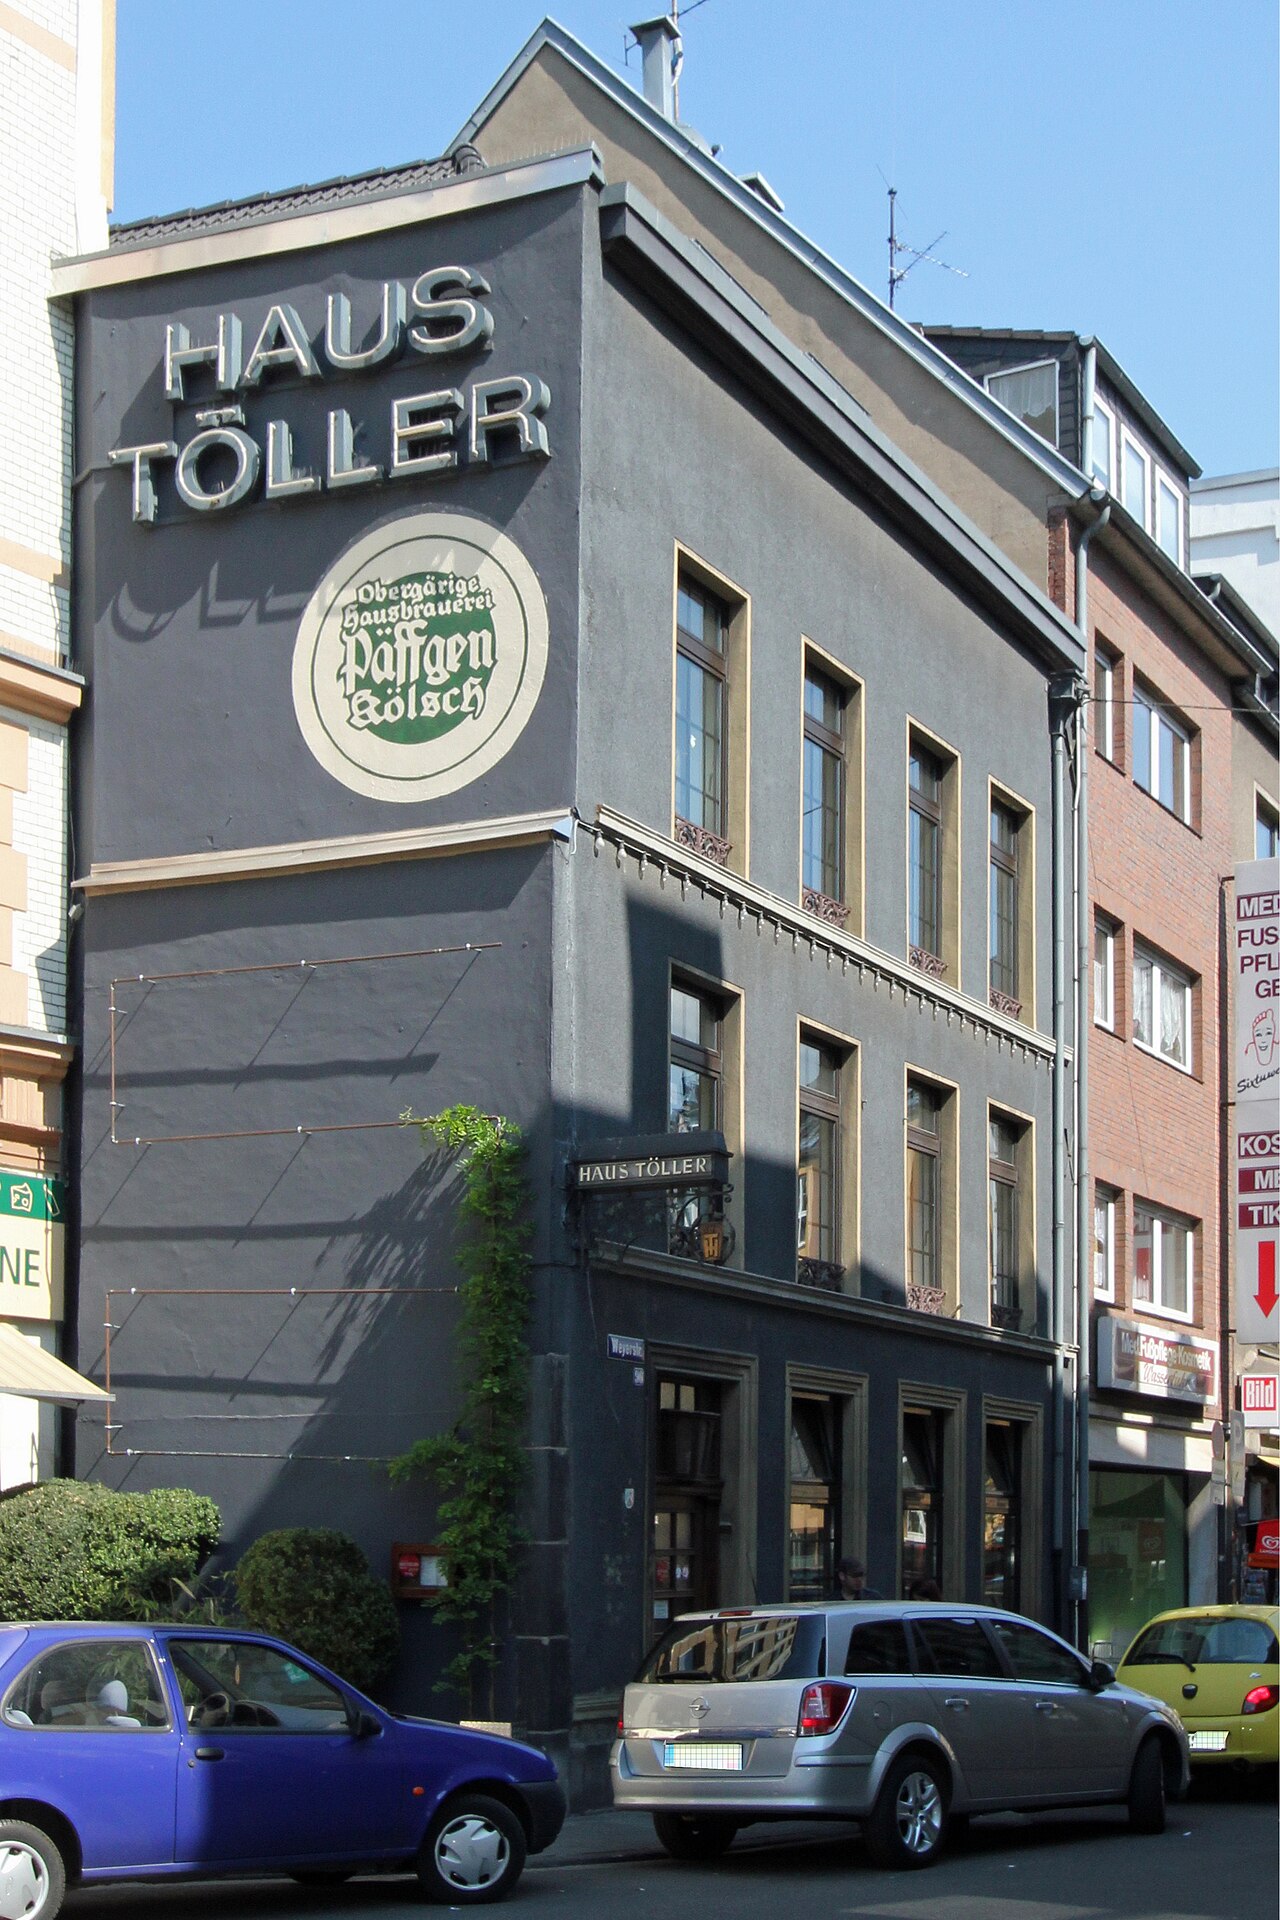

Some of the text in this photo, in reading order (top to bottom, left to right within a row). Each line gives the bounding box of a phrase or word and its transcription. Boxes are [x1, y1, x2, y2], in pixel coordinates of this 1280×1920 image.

[165, 266, 495, 399] HAUS
[108, 372, 551, 526] TÖLLER
[358, 574, 480, 604] Obergärige
[343, 589, 494, 633] Hausbrauerei
[340, 619, 494, 696] Päffgen
[350, 676, 485, 729] Kölsch
[1241, 952, 1279, 974] PFL
[579, 1157, 706, 1182] HAUS TÖLLER
[1254, 1169, 1279, 1190] M
[1246, 1380, 1274, 1408] Bild
